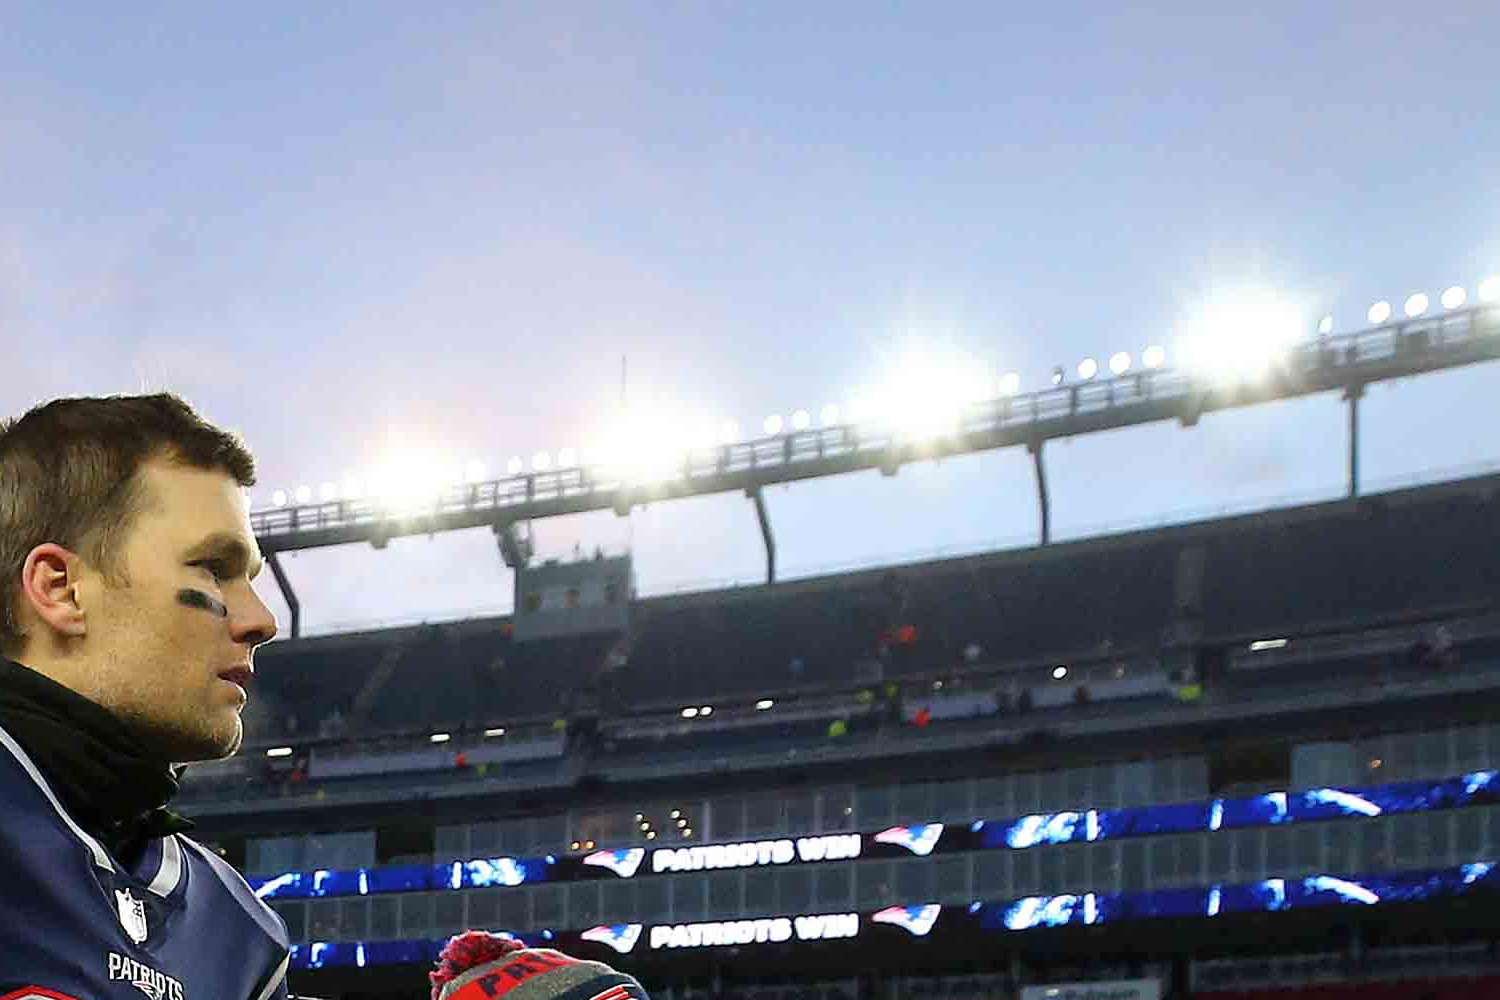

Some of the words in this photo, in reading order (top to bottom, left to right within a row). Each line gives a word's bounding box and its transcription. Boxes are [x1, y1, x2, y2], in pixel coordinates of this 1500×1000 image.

[653, 839, 795, 873] PATRIOTS
[797, 834, 862, 861] WIN
[650, 917, 792, 949] PATRIOTS
[794, 913, 859, 940] WIN
